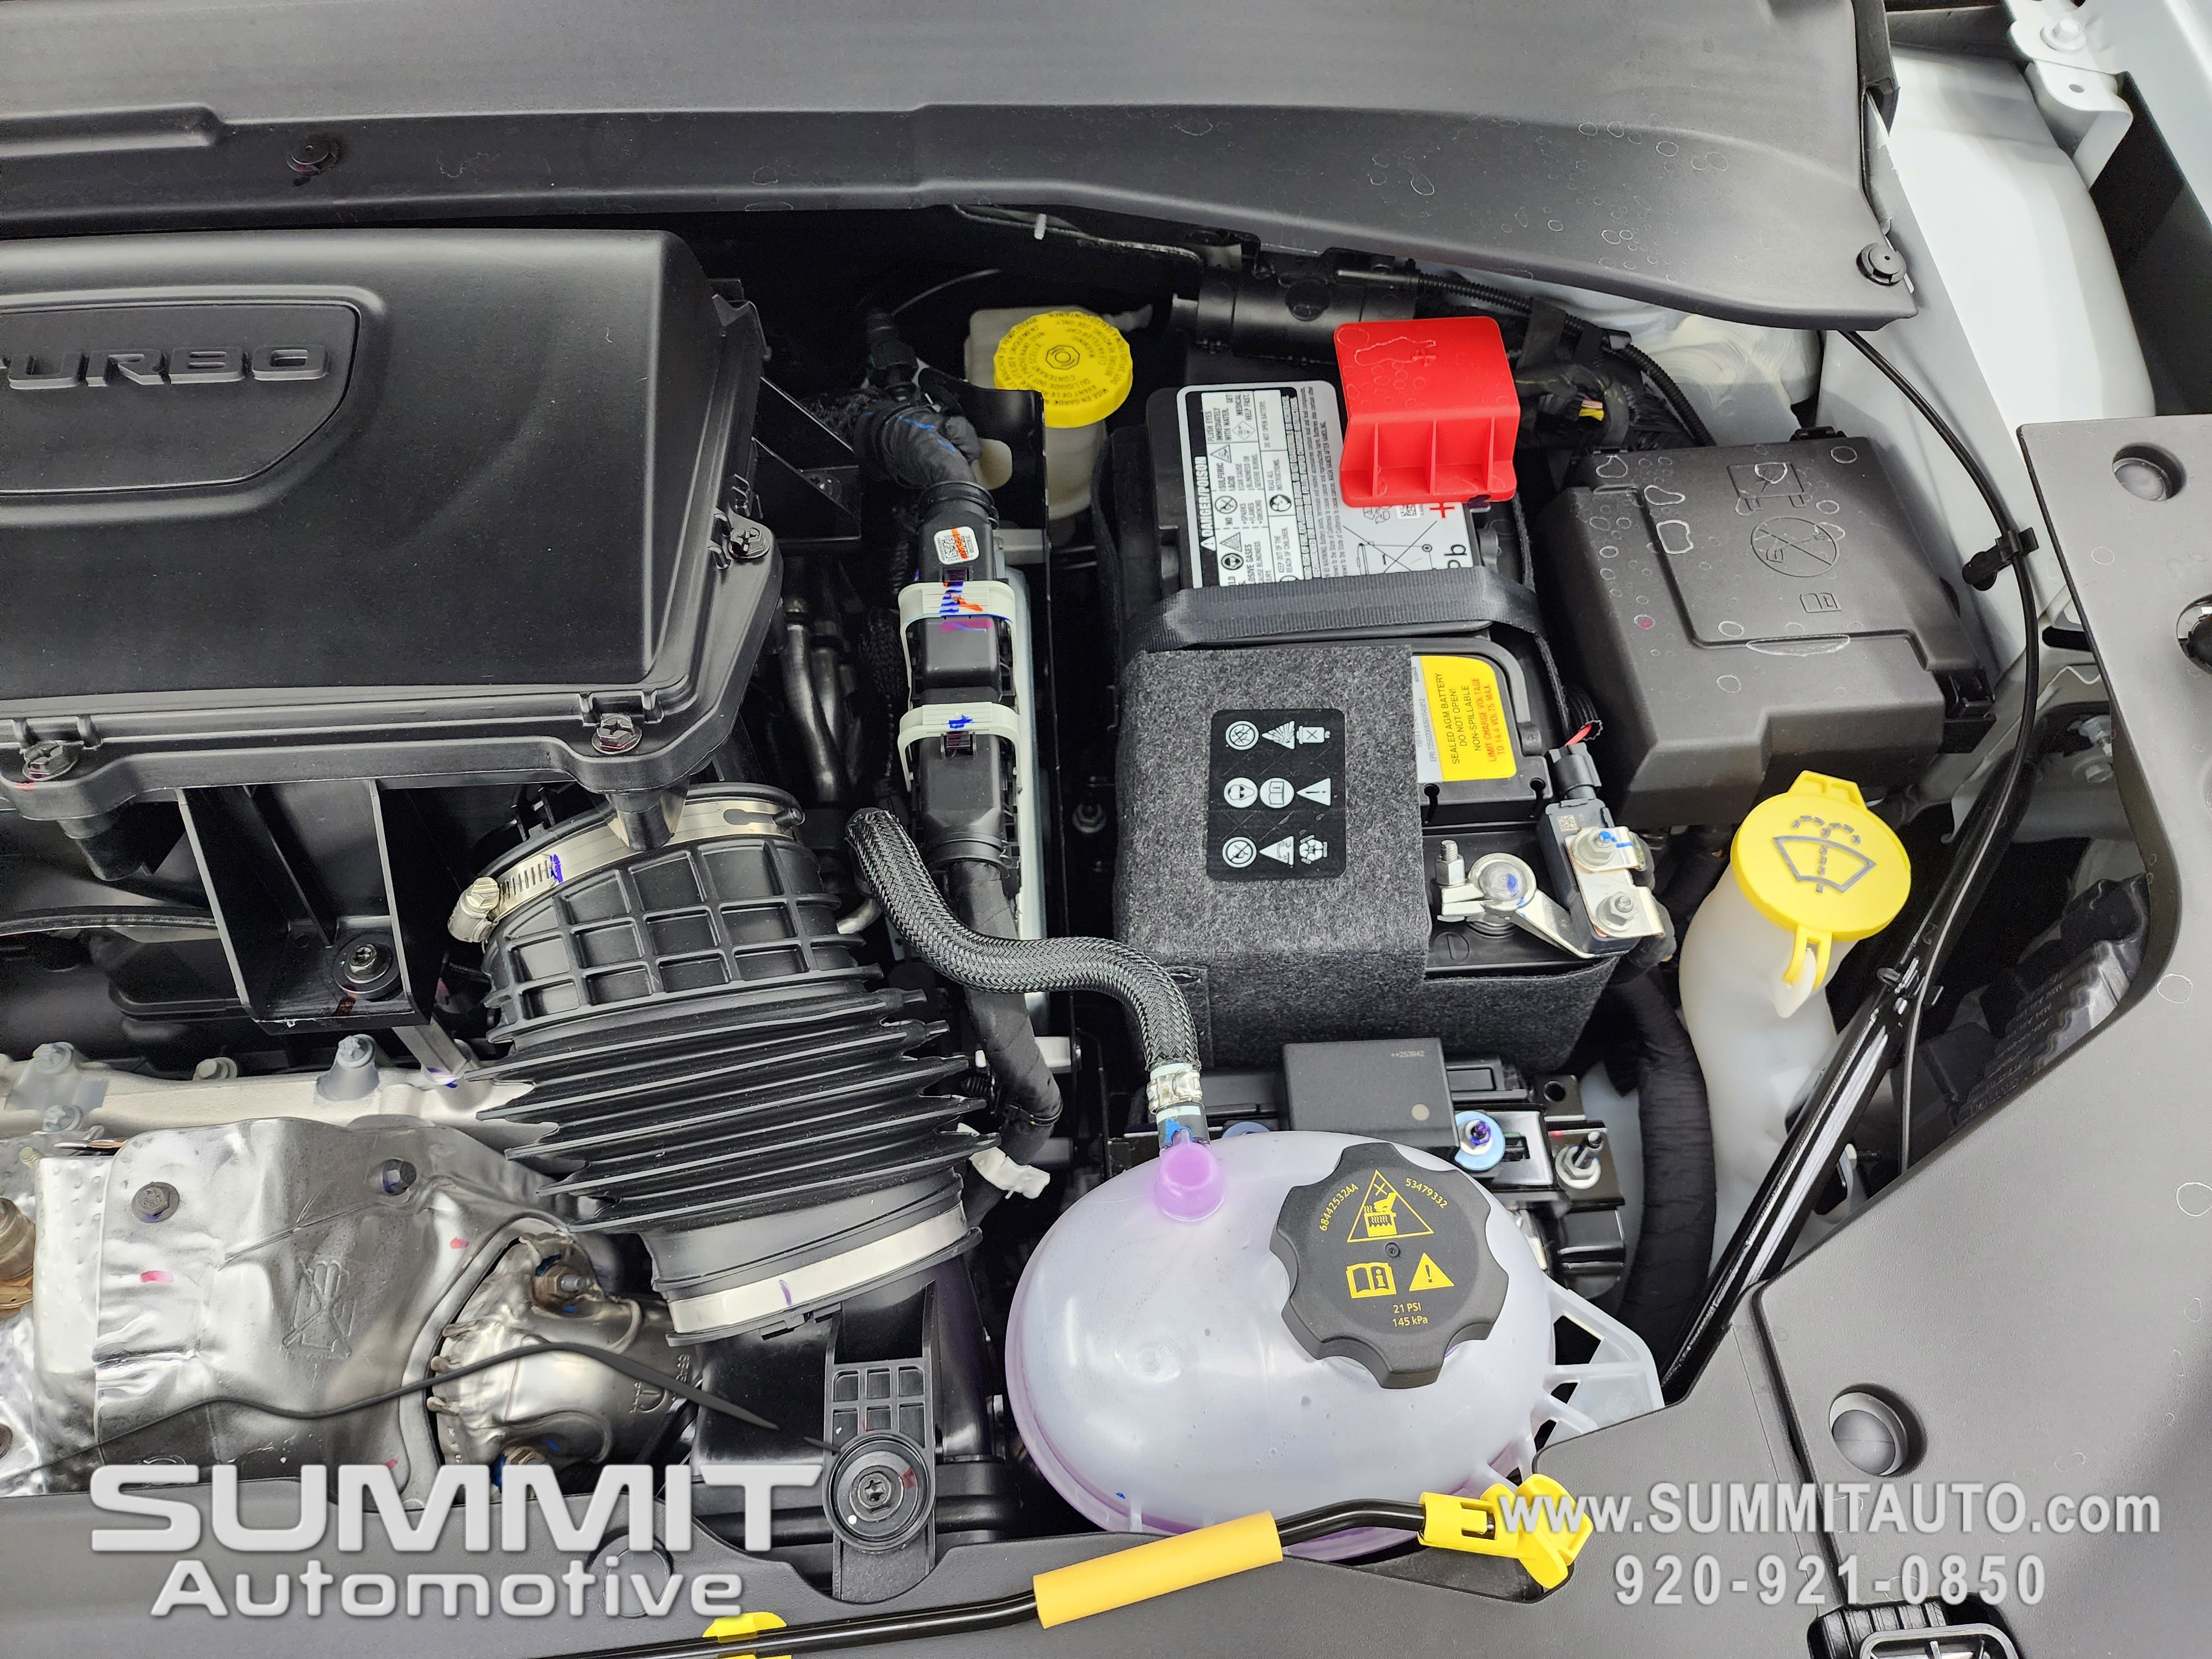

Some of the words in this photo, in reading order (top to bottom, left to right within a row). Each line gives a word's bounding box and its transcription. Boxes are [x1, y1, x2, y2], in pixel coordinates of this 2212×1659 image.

[0, 346, 328, 390] URBO
[1217, 463, 1225, 489] SULFURIC
[1194, 456, 1214, 537] DANGER/POISON
[1244, 544, 1253, 562] GASES
[1434, 673, 1448, 709] BATTERY
[1449, 688, 1461, 713] OPEN!
[1471, 678, 1483, 709] VOLTAGE
[1442, 711, 1452, 729] AGM
[1454, 716, 1464, 732] NOT
[1461, 686, 1481, 751] NON-SPILLABLE
[1479, 711, 1492, 740] CHARGE
[1488, 703, 1499, 726] VOLTS
[1447, 732, 1460, 764] SEALED
[1459, 734, 1468, 747] DO
[1494, 729, 1502, 742] 14.4
[1485, 743, 1496, 762] LIMIT
[1496, 745, 1505, 755] TO
[1405, 1178, 1448, 1209] 53479332
[1319, 1183, 1359, 1232] 68442532AA
[1393, 1304, 1405, 1314] 21
[1407, 1302, 1422, 1313] PSI
[1392, 1317, 1410, 1327] 145
[1412, 1315, 1428, 1326] kPa
